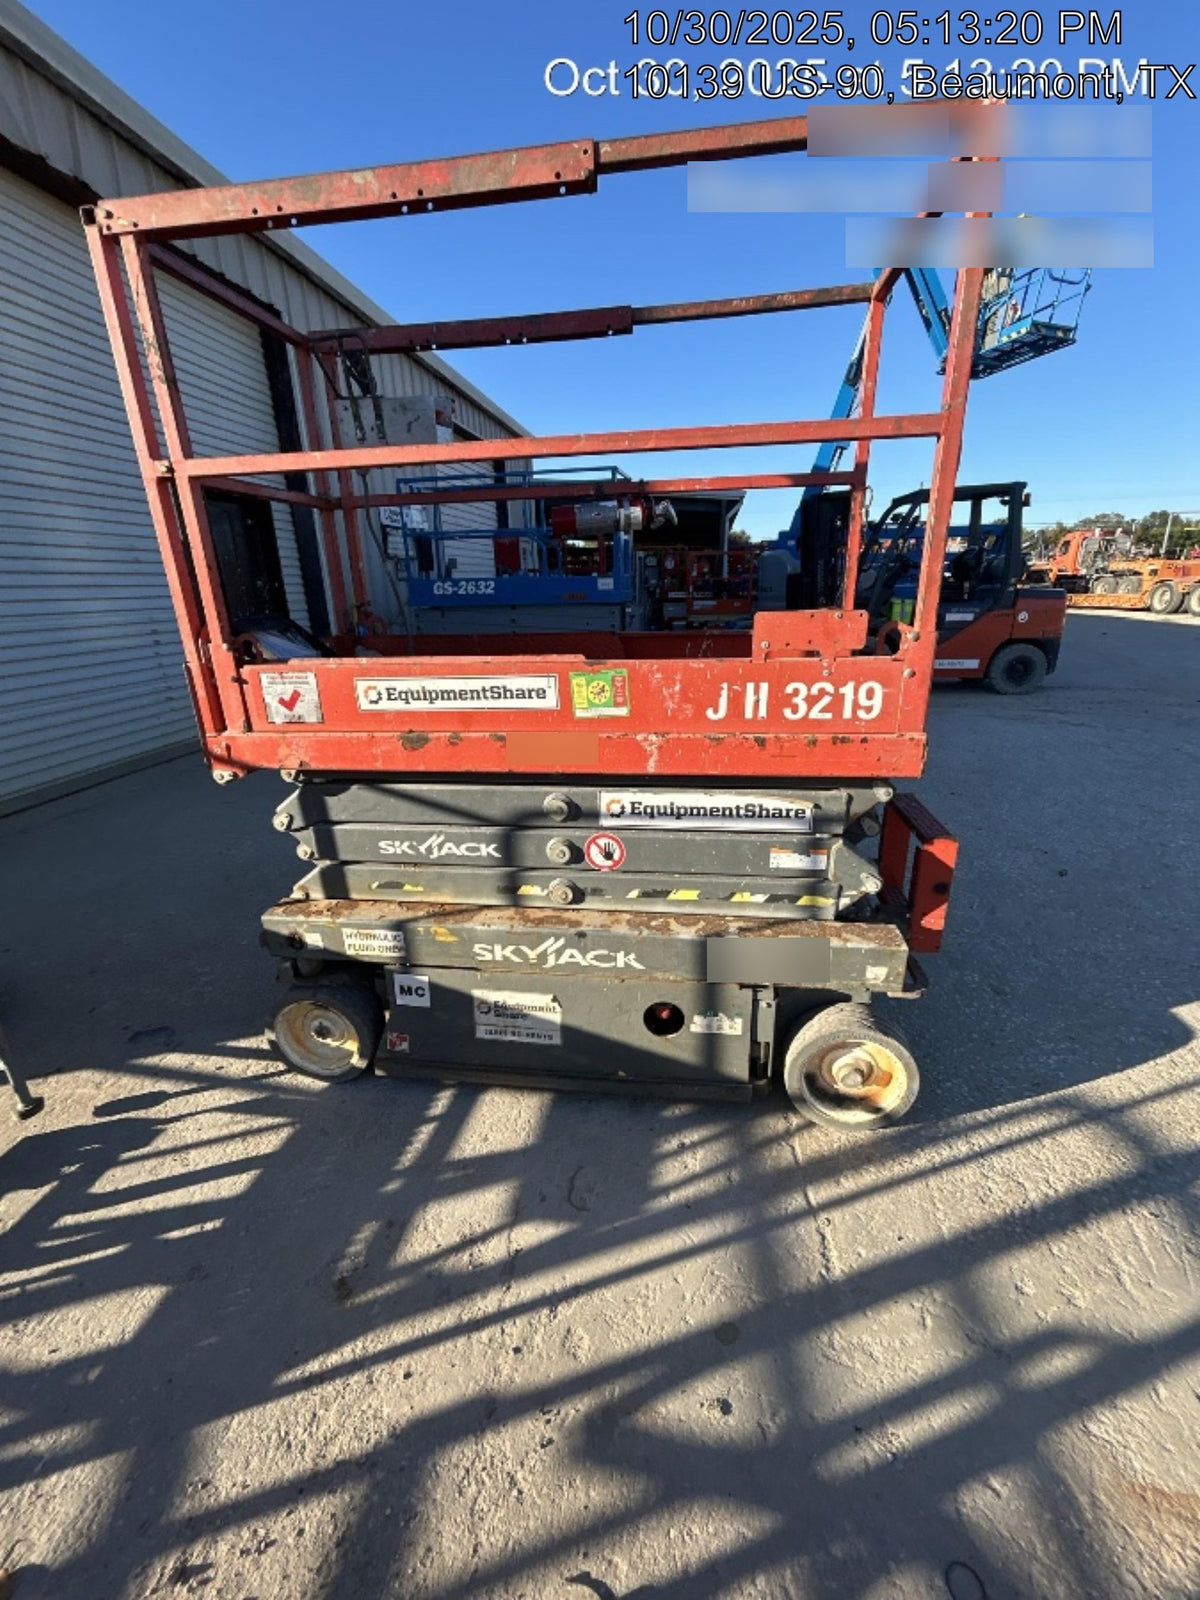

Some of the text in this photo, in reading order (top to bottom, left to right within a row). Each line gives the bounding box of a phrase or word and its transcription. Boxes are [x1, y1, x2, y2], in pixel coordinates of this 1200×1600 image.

[432, 581, 496, 595] GS-2632
[385, 685, 546, 705] EquipmentShare
[783, 680, 883, 721] 3219
[629, 801, 806, 820] EquipmentShare
[377, 833, 502, 859] SKYJACK
[471, 936, 646, 969] SKYJACK
[399, 984, 426, 998] MC
